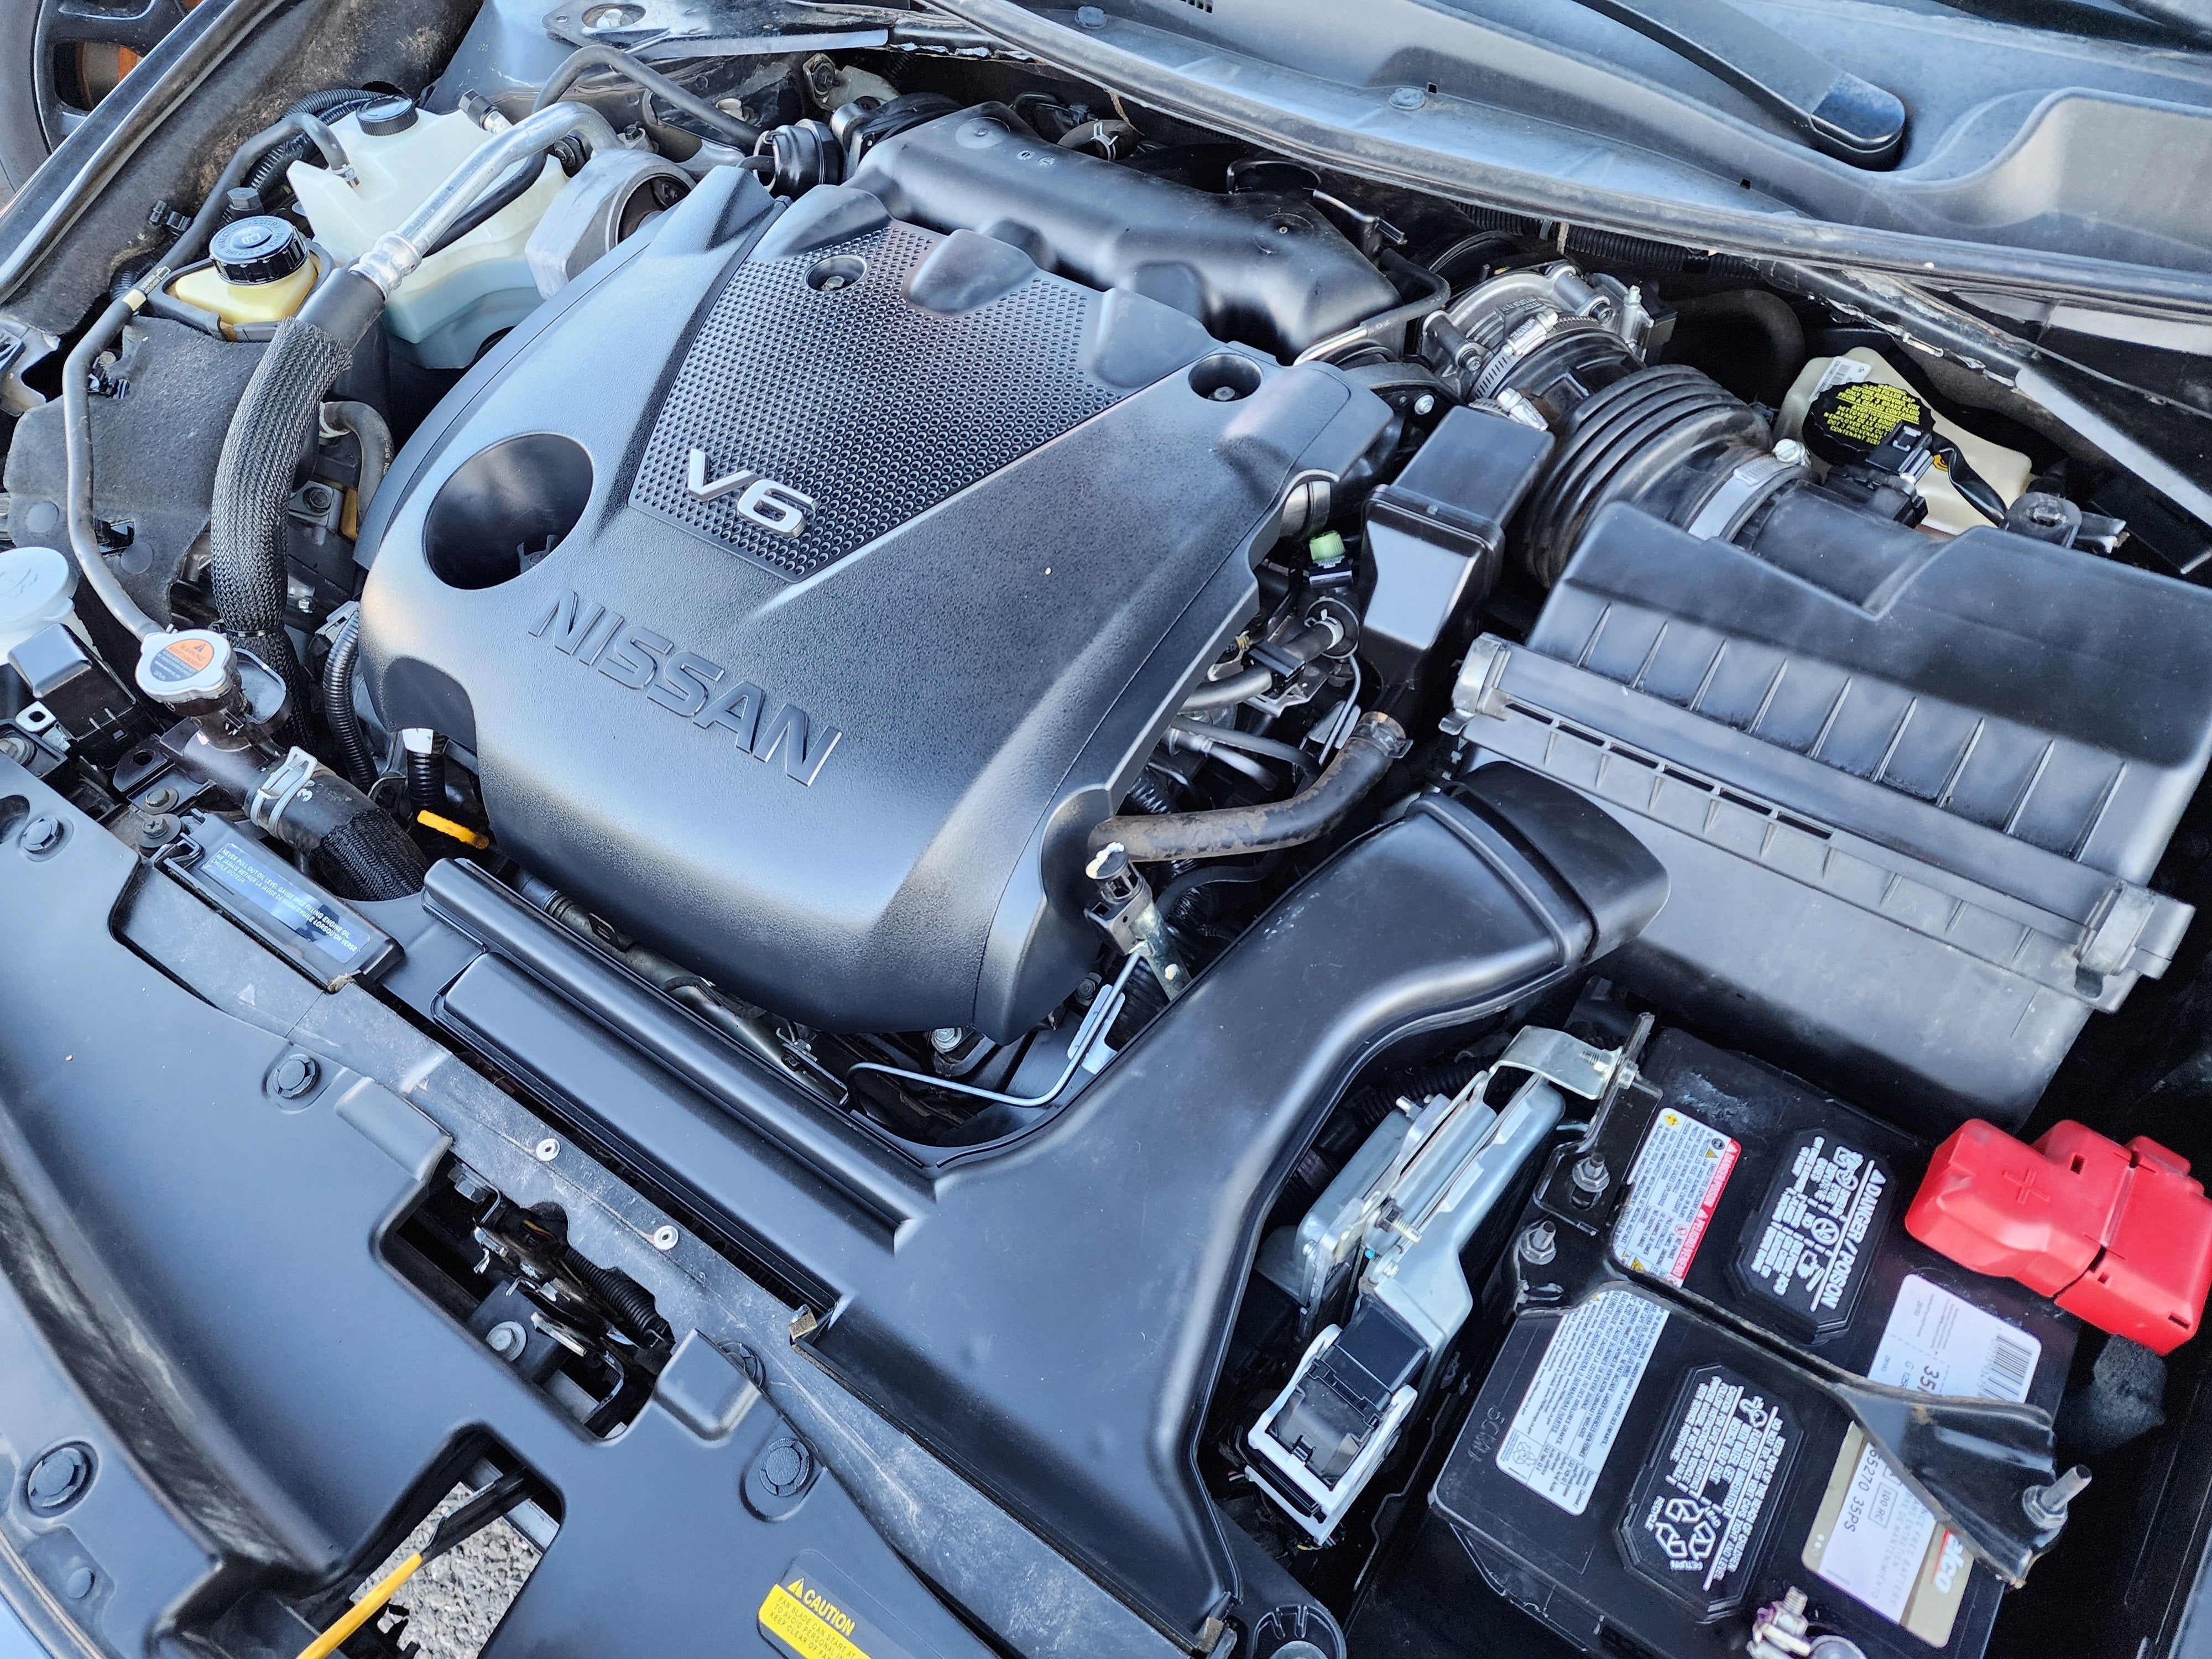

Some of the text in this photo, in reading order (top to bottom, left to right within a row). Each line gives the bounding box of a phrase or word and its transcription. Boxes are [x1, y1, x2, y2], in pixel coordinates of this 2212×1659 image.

[1881, 388, 1901, 399] FILLER
[1835, 410, 1856, 420] AVANT
[1881, 400, 1902, 410] BRAKE
[687, 448, 818, 538] V6
[528, 588, 842, 787] NISSAN
[222, 848, 237, 860] NEVER
[236, 858, 248, 868] PULL
[247, 866, 258, 874] OUT
[264, 878, 278, 889] LEVEL
[304, 903, 323, 919] FILLING
[322, 916, 342, 932] ENGINE
[222, 859, 239, 871] JAMAIS
[238, 869, 256, 883] RETIRER
[261, 885, 276, 896] JAUGE
[341, 938, 357, 952] VERSE
[1825, 1183, 1840, 1203] EYES
[1833, 1188, 1850, 1214] SHIELD
[1802, 1212, 1815, 1228] NO
[1619, 1315, 1627, 1326] CAN
[1737, 1423, 1752, 1442] WITH
[1771, 1418, 1782, 1430] DO
[1746, 1428, 1762, 1451] FLUSH
[1766, 1430, 1778, 1446] NOT
[1772, 1436, 1785, 1455] KEEP
[1709, 1417, 1741, 1484] MEDICAL HELP FAST
[1739, 1450, 1754, 1470] EYES
[1722, 1465, 1735, 1483] GET
[1754, 1459, 1765, 1479] KEEP
[1766, 1455, 1778, 1472] OUT
[1762, 1471, 1772, 1483] OF
[1746, 1479, 1759, 1499] VENT
[1755, 1483, 1768, 1499] THE
[1844, 1449, 1882, 1531] 65270 35PS
[1645, 1496, 1665, 1531] RECYCLE
[1738, 1498, 1751, 1518] CAPS
[1746, 1498, 1761, 1522] REACH
[1875, 1490, 1891, 1521] 100 RC
[1704, 1506, 1721, 1528] LEAD
[1730, 1519, 1743, 1541] TIGHT
[1723, 1541, 1734, 1557] AND
[1728, 1534, 1747, 1571] CHILDREN
[1670, 1560, 1703, 1571] RETURN
[1890, 1530, 1921, 1605] FREE BATTERY
[1935, 1536, 1964, 1593] elco
[804, 1589, 855, 1637] CAUTION
[769, 1611, 786, 1625] KEEP
[787, 1625, 807, 1644] CLEAR
[808, 1642, 817, 1651] OF
[774, 1603, 834, 1655] TO AVOID PERSONAL
[778, 1596, 791, 1609] FAN
[791, 1606, 811, 1625] BLADE
[812, 1623, 825, 1636] CAN
[826, 1634, 846, 1652] START
